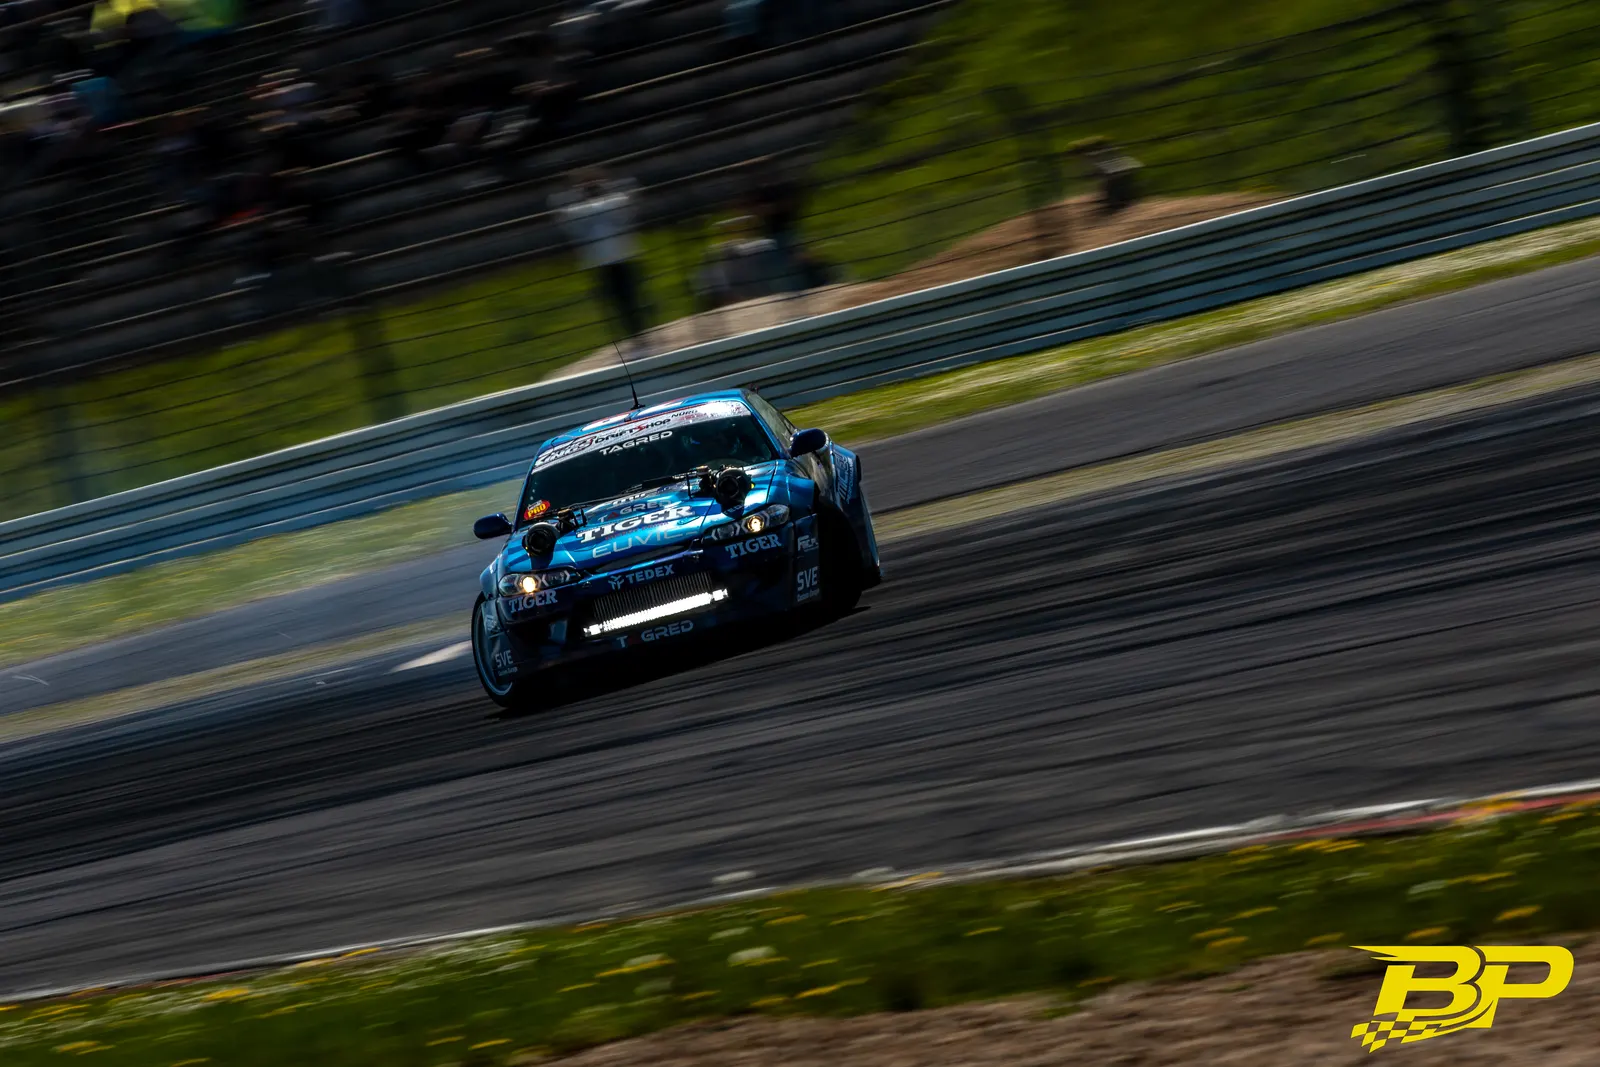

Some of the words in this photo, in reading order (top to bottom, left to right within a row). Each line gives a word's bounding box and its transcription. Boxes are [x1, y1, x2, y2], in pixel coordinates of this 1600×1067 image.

[599, 430, 673, 456] TAGRED
[527, 503, 546, 517] PRO
[597, 499, 672, 523] TAGRED
[576, 505, 695, 544] TIGER
[725, 533, 782, 558] TIGER
[626, 564, 675, 584] TEDEX
[797, 566, 818, 591] SVE
[508, 590, 558, 613] TIGER
[616, 620, 694, 649] TGRED
[495, 649, 514, 668] SVE
